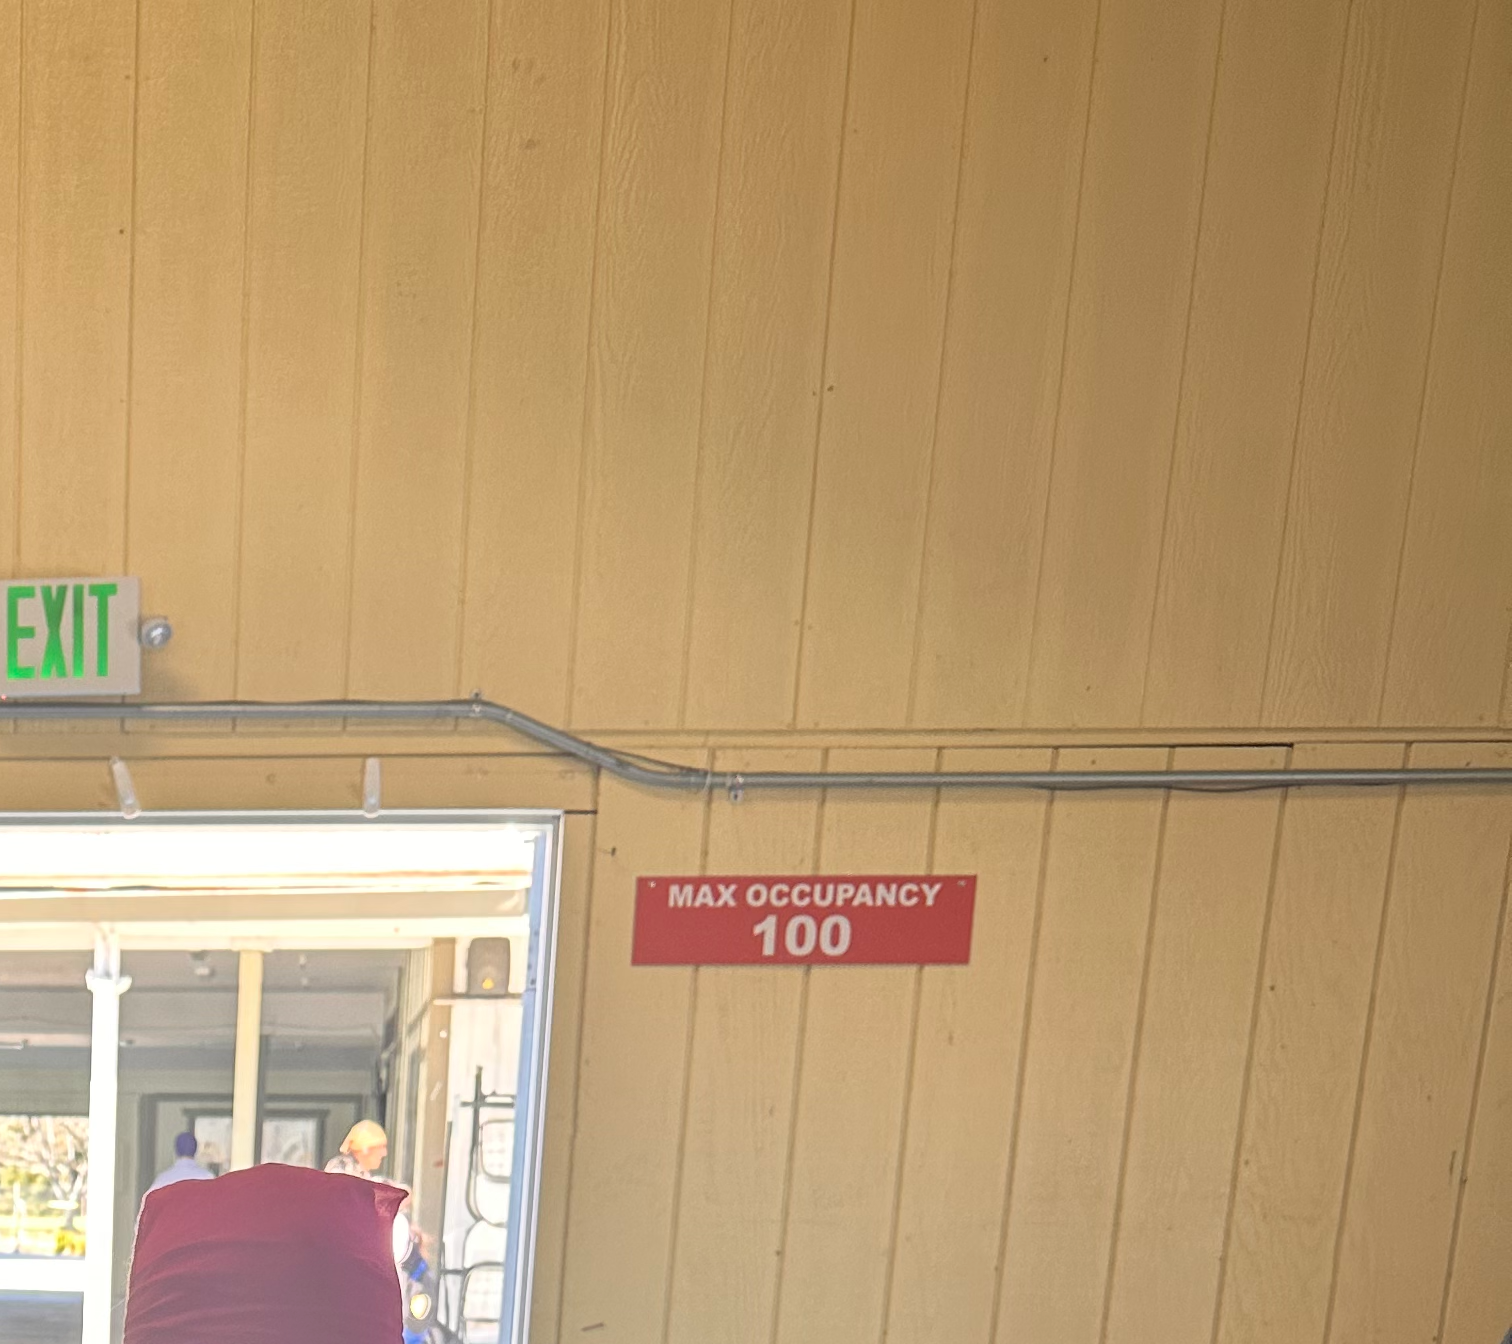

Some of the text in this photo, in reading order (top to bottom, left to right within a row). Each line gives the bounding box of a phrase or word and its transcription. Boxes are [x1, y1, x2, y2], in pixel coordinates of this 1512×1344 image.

[6, 582, 118, 679] EXIT
[668, 881, 941, 907] MAX OCCUPANCY
[752, 917, 852, 957] 100
